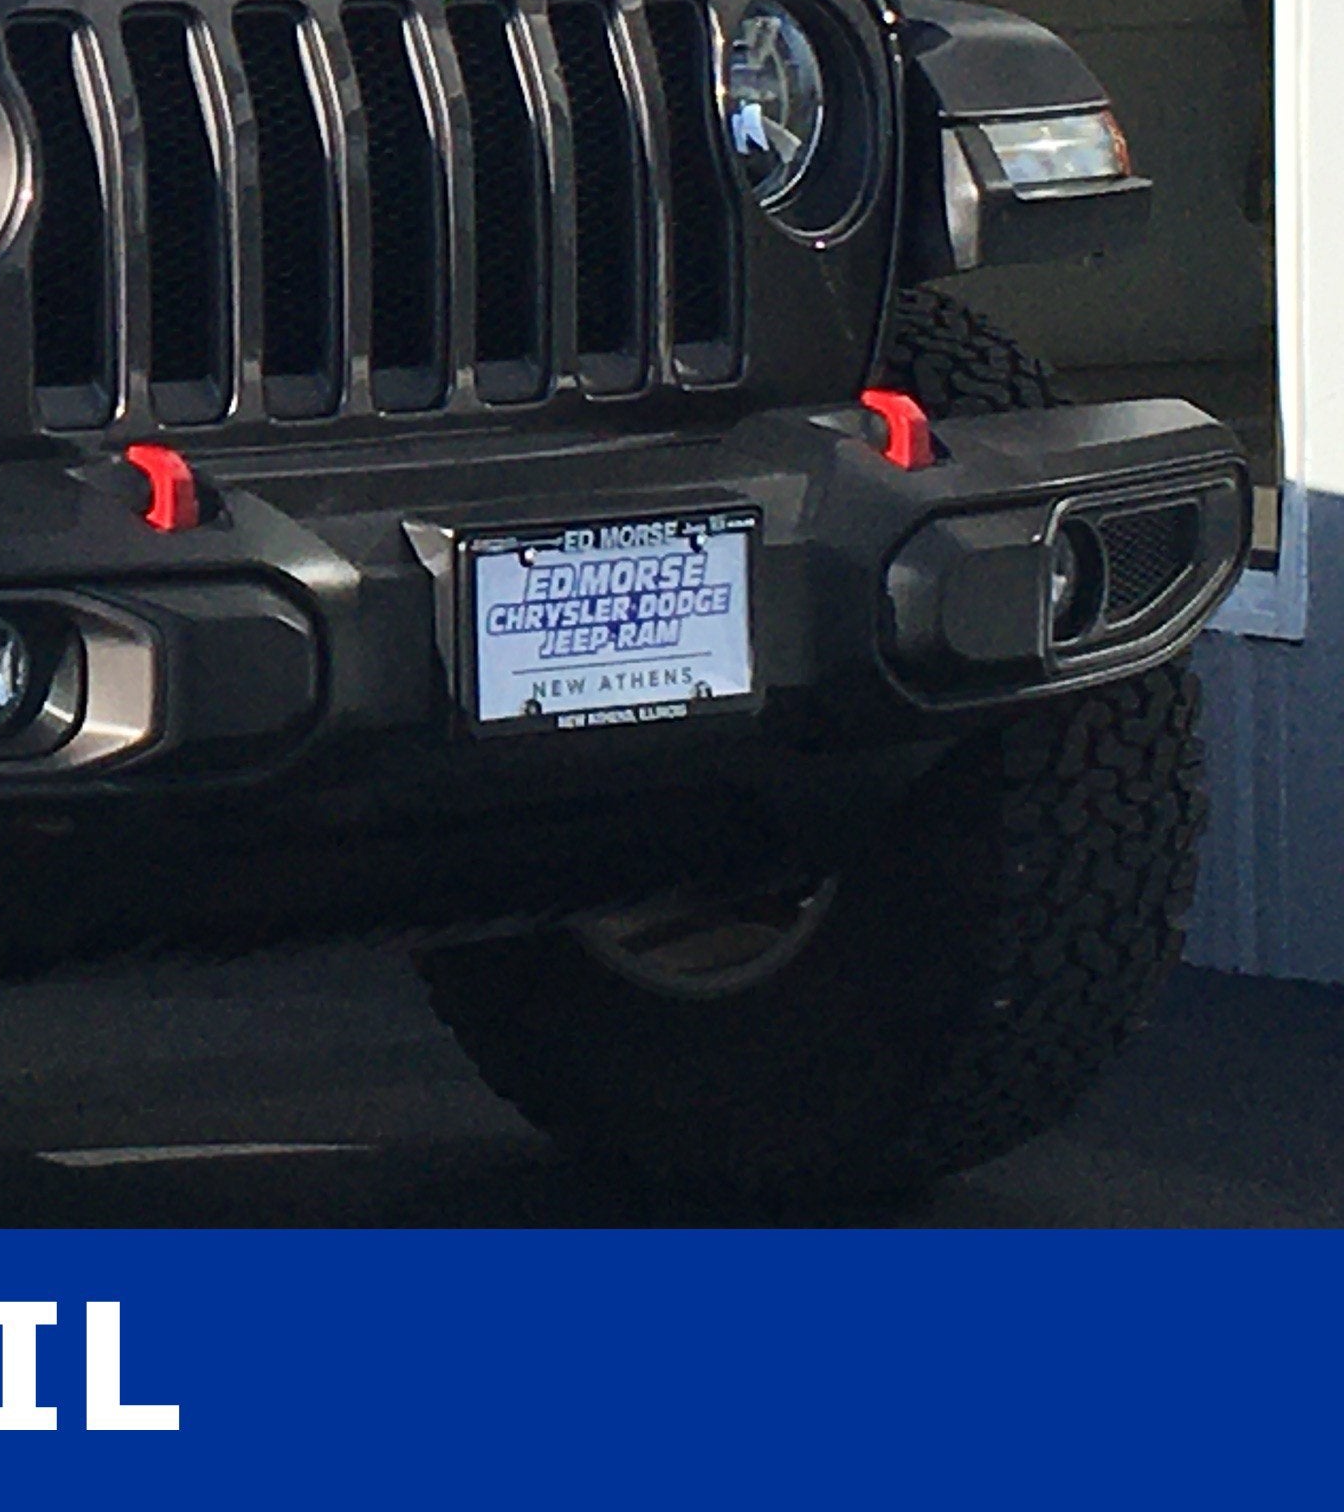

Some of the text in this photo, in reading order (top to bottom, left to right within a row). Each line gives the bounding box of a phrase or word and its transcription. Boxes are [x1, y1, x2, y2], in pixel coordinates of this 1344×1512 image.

[564, 529, 593, 552] ED
[600, 520, 678, 548] MORSE
[525, 553, 707, 601] ED MORSE
[487, 584, 730, 635] CHRYSLER DODGE
[540, 618, 681, 658] JEEP RAM
[532, 666, 693, 699] NEW ATHENS
